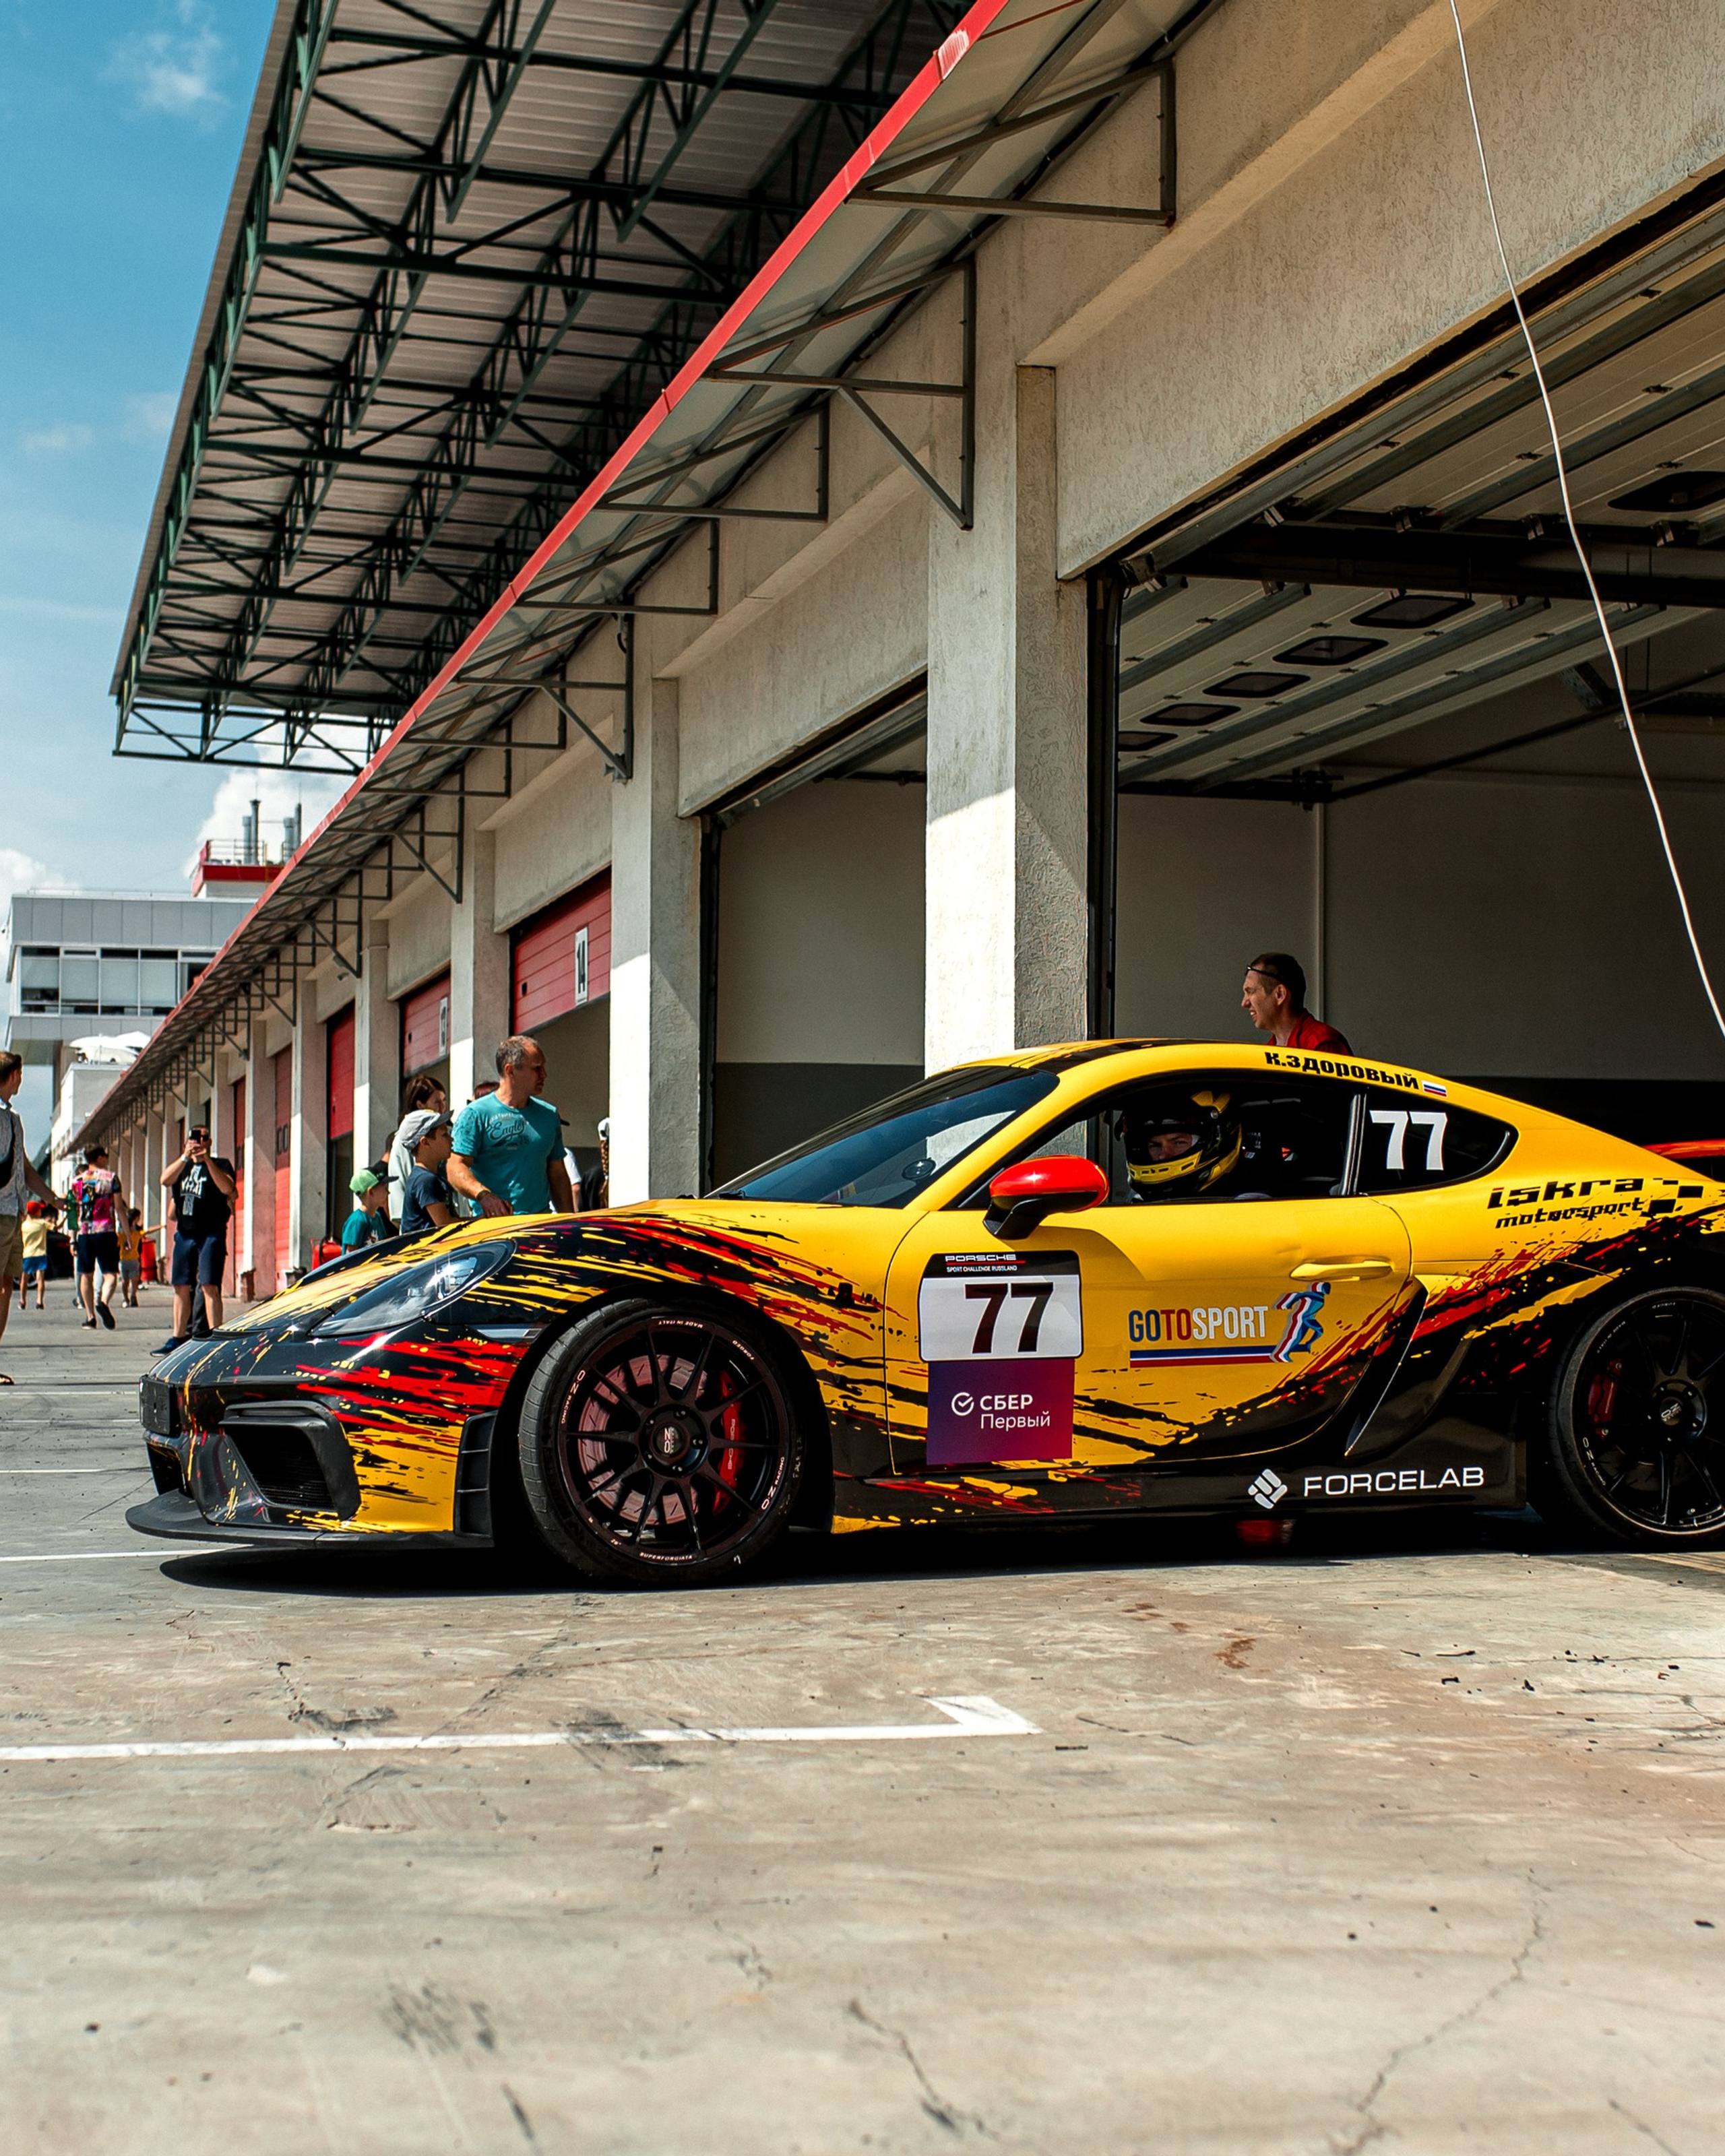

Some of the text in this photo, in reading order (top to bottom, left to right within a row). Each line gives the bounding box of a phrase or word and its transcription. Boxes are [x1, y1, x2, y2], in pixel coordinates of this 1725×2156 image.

[1369, 1110, 1448, 1170] 77
[945, 1254, 1017, 1262] PORSCHE
[964, 1281, 1054, 1354] 77
[980, 1394, 1033, 1412] СБЕР
[980, 1411, 1050, 1432] Первый
[1303, 1466, 1484, 1497] FORCELAB
